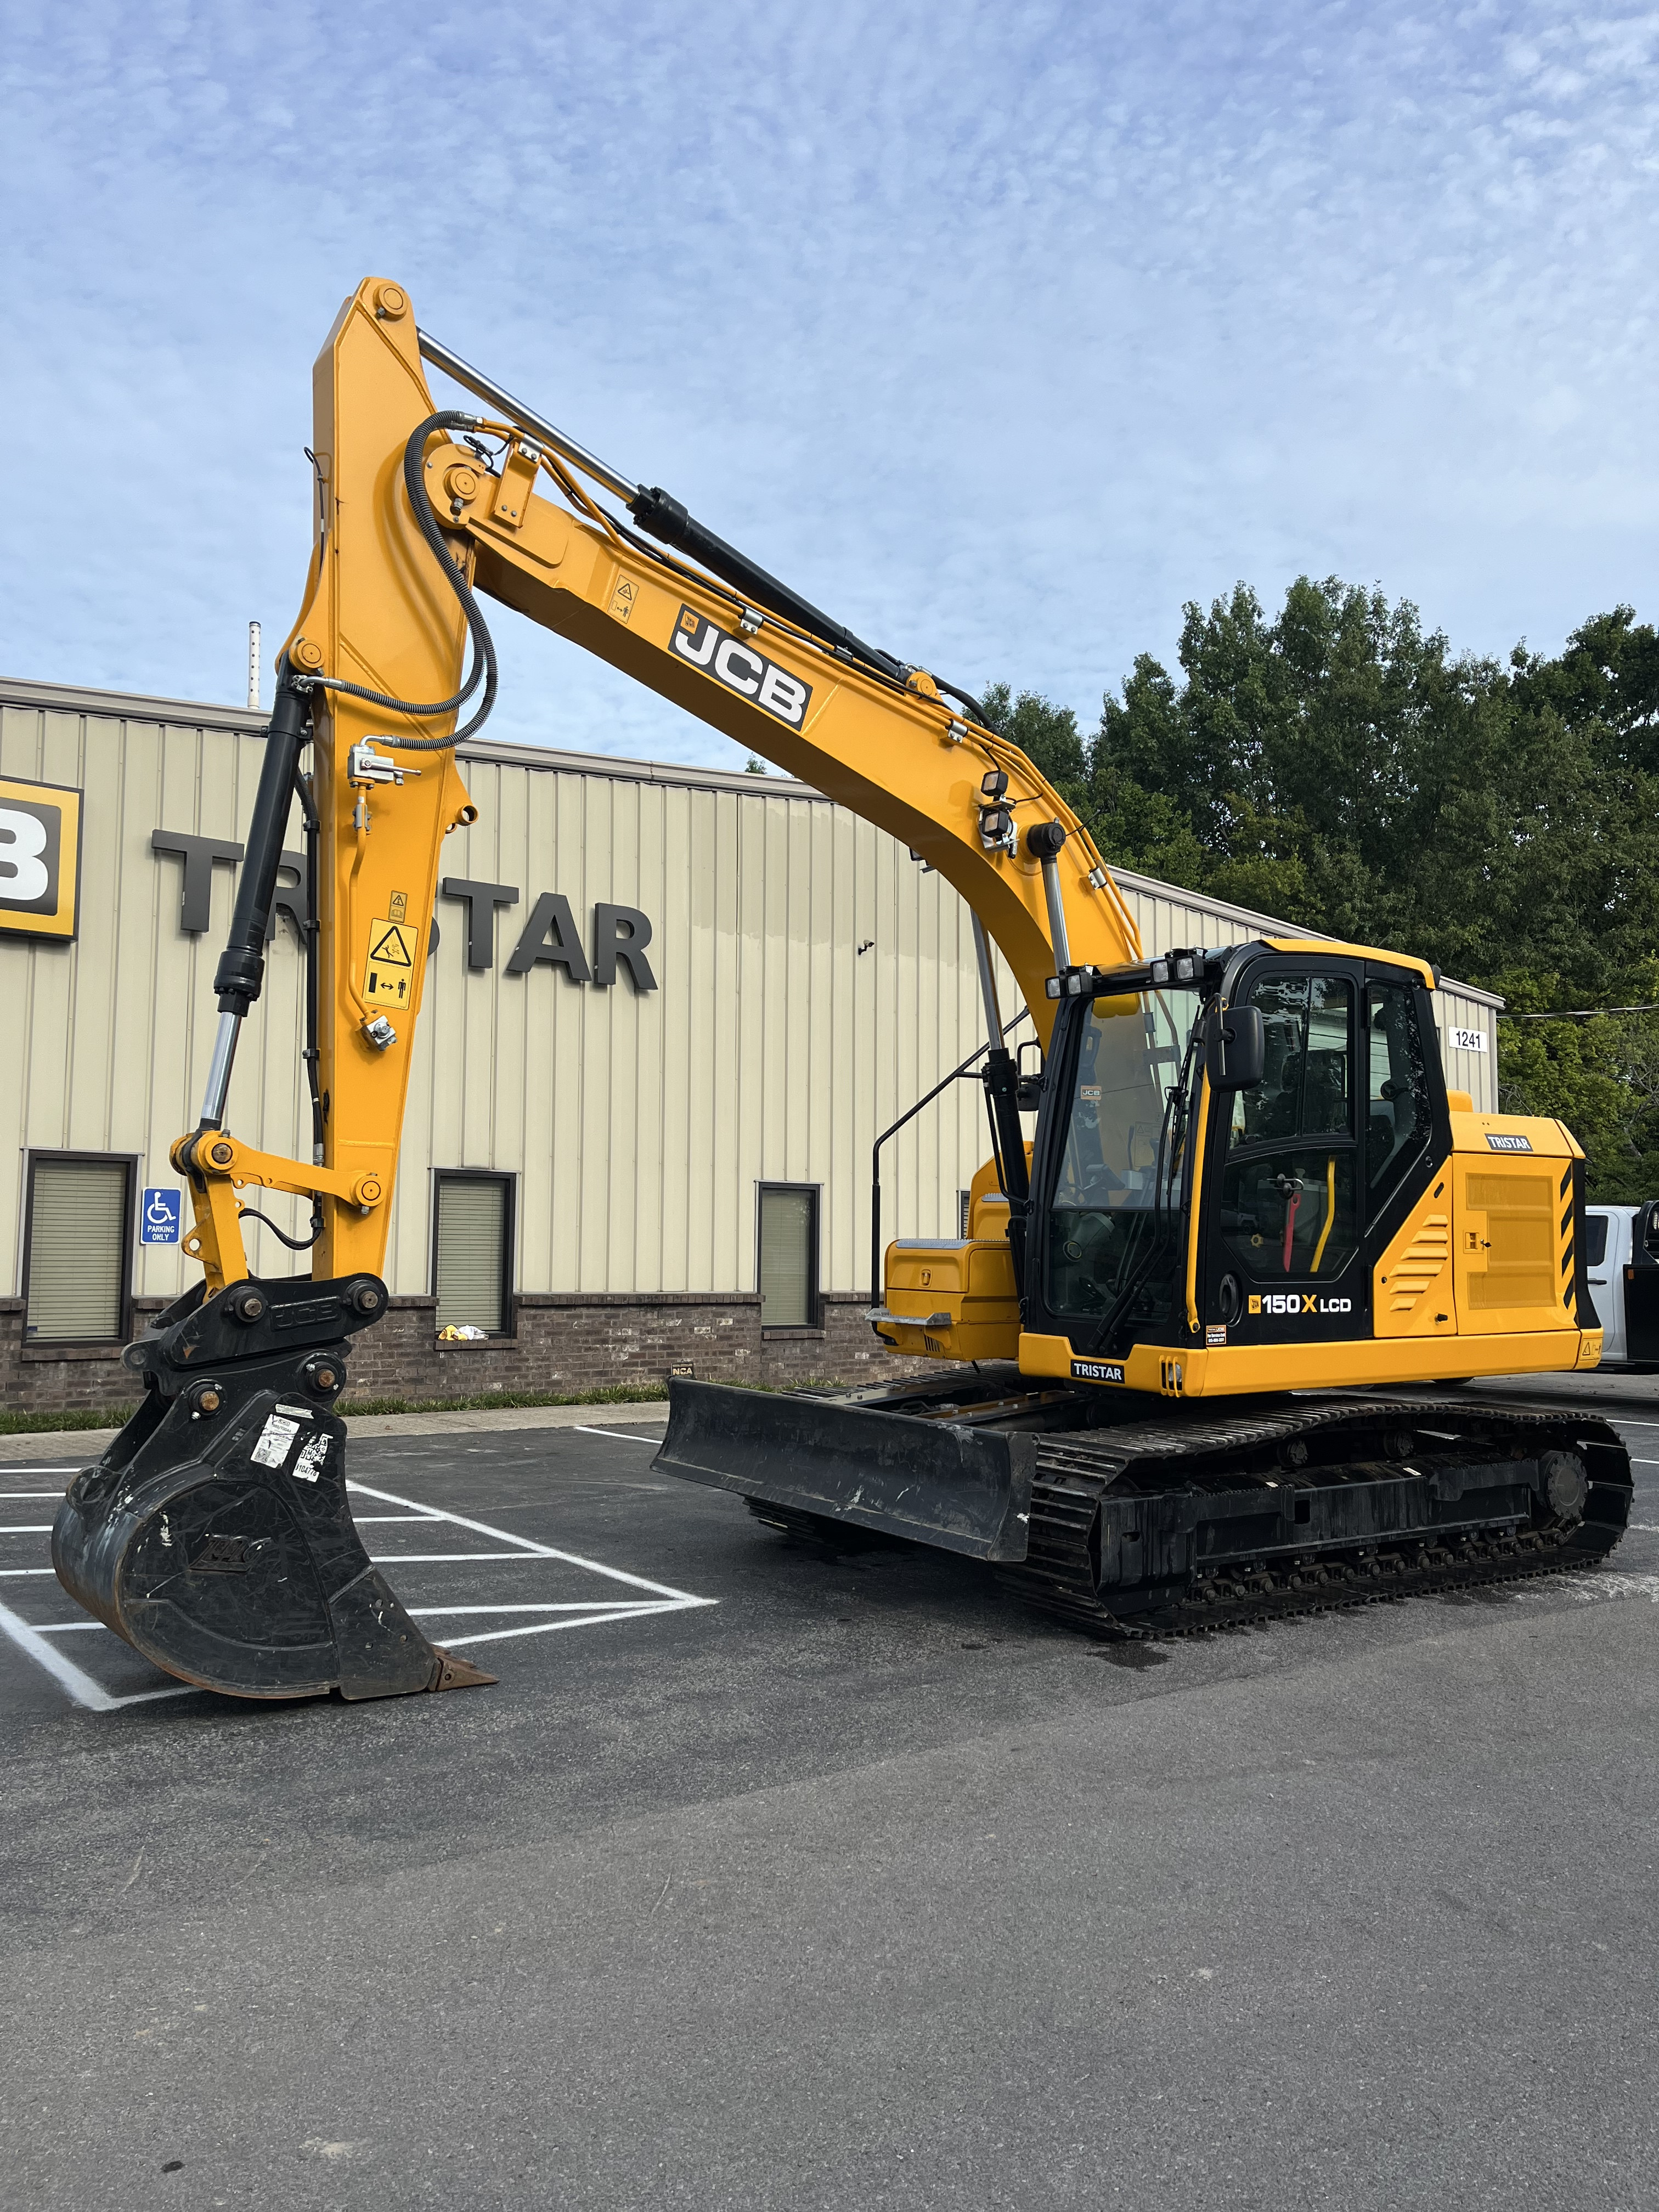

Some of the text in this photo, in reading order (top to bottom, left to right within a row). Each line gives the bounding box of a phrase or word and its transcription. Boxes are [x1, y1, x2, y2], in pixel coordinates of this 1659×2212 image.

[675, 625, 806, 723] JCB
[151, 829, 658, 990] TRTAR
[1456, 1030, 1480, 1048] 1241
[1487, 1136, 1531, 1149] TRISTAR
[147, 1225, 175, 1233] PARKING
[1320, 1298, 1352, 1312] LCD
[1074, 1363, 1122, 1380] TRISTAR
